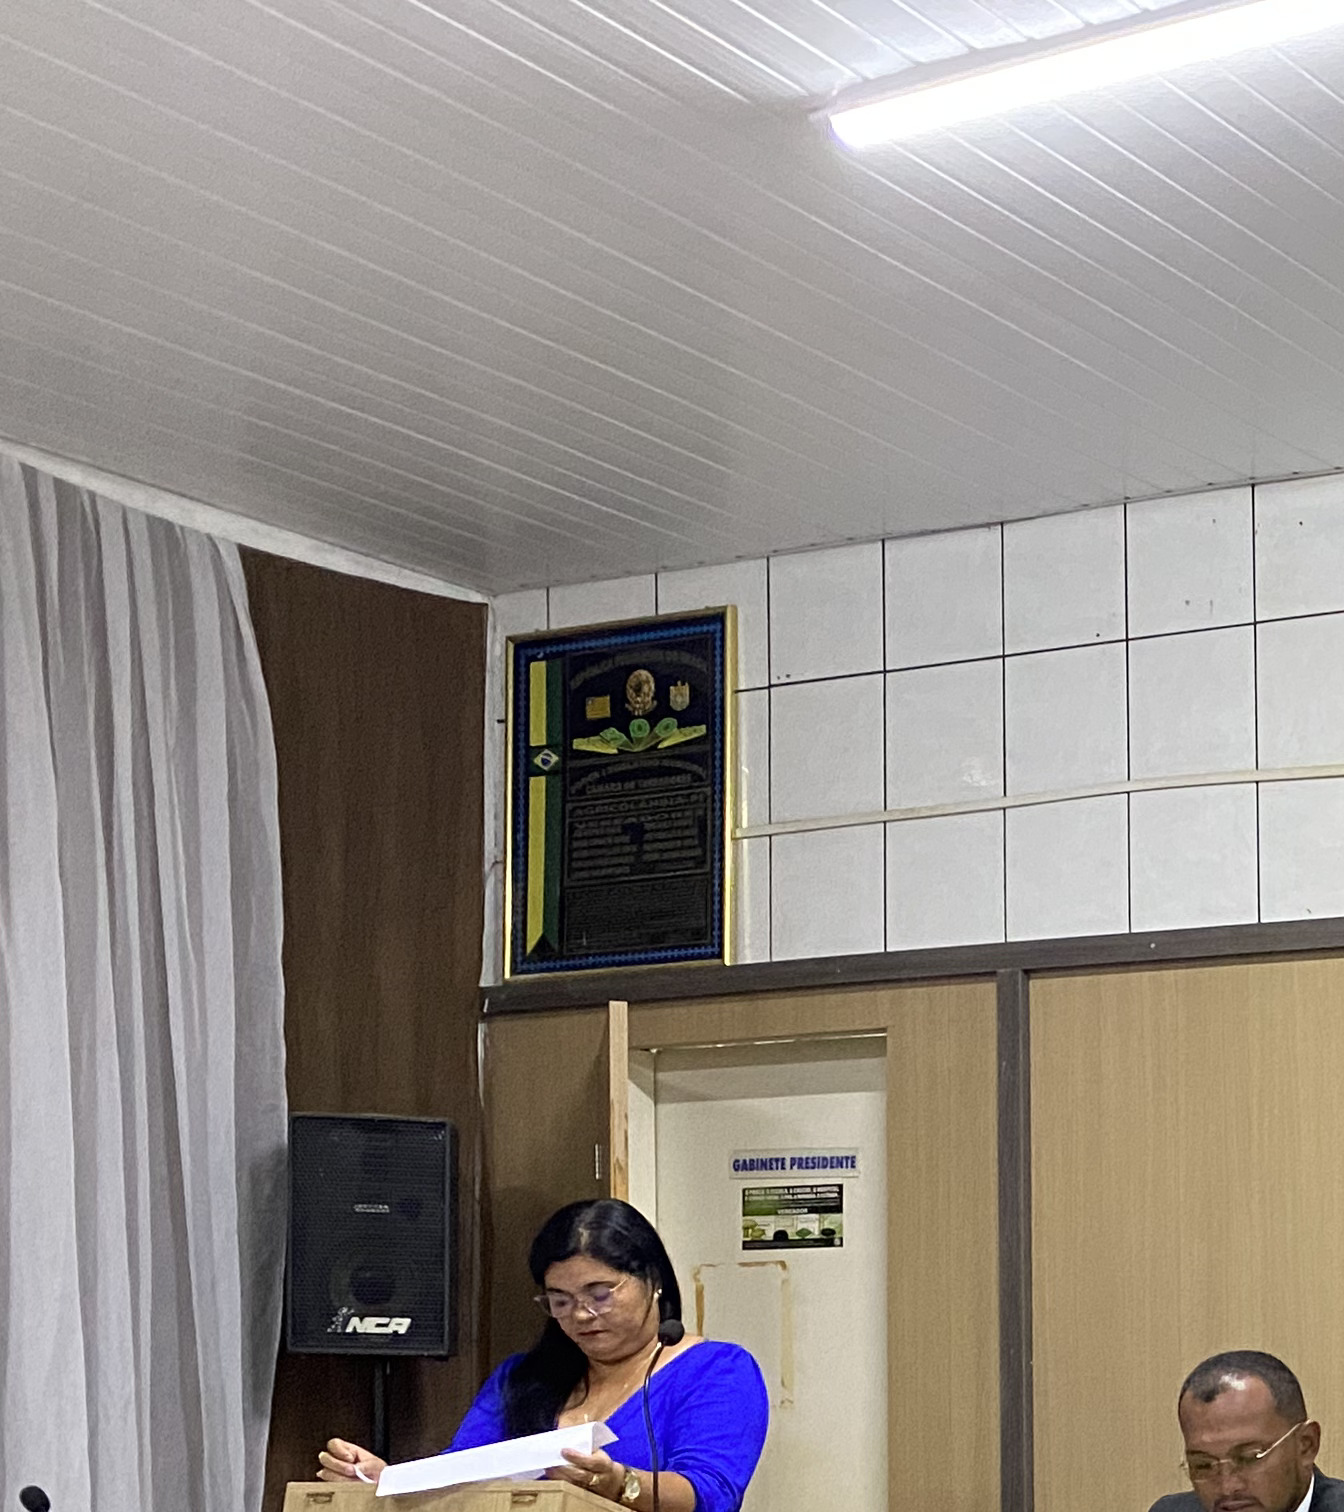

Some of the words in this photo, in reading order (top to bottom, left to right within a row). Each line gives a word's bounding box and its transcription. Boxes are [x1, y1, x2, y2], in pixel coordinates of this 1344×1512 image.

[732, 1157, 786, 1172] GABINETE
[790, 1155, 857, 1170] PRESIDENTE
[345, 1317, 411, 1334] NCA
